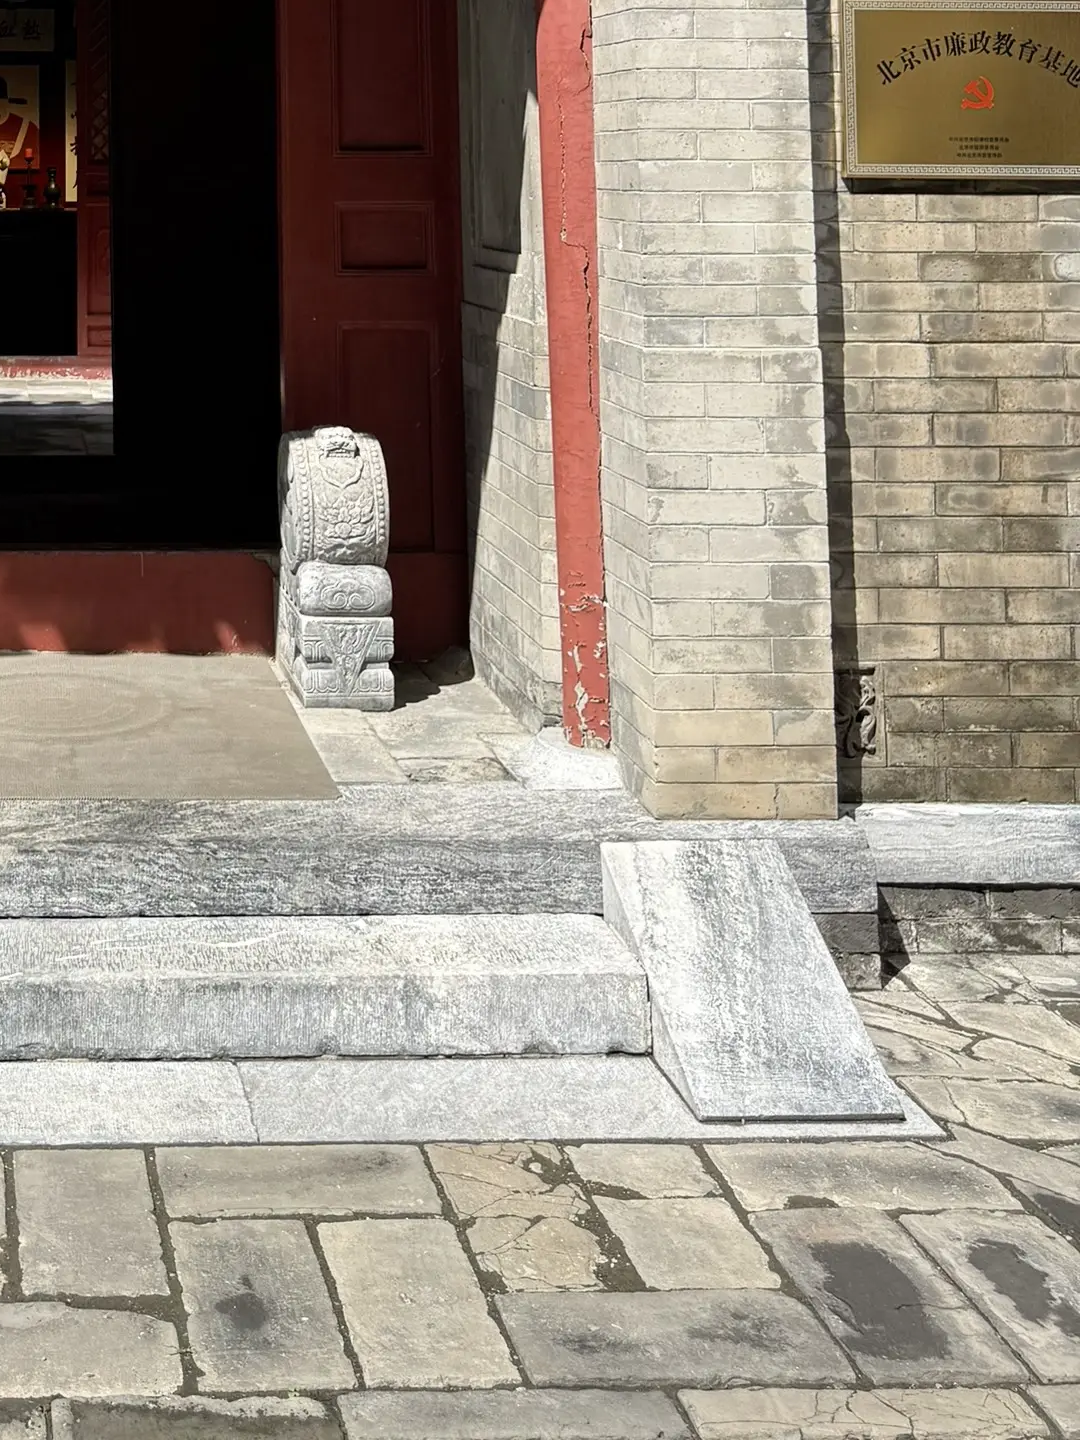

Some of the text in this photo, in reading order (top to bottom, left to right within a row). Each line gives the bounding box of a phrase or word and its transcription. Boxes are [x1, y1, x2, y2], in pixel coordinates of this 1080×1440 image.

[875, 29, 1080, 89] 北京市廉政教育基地
